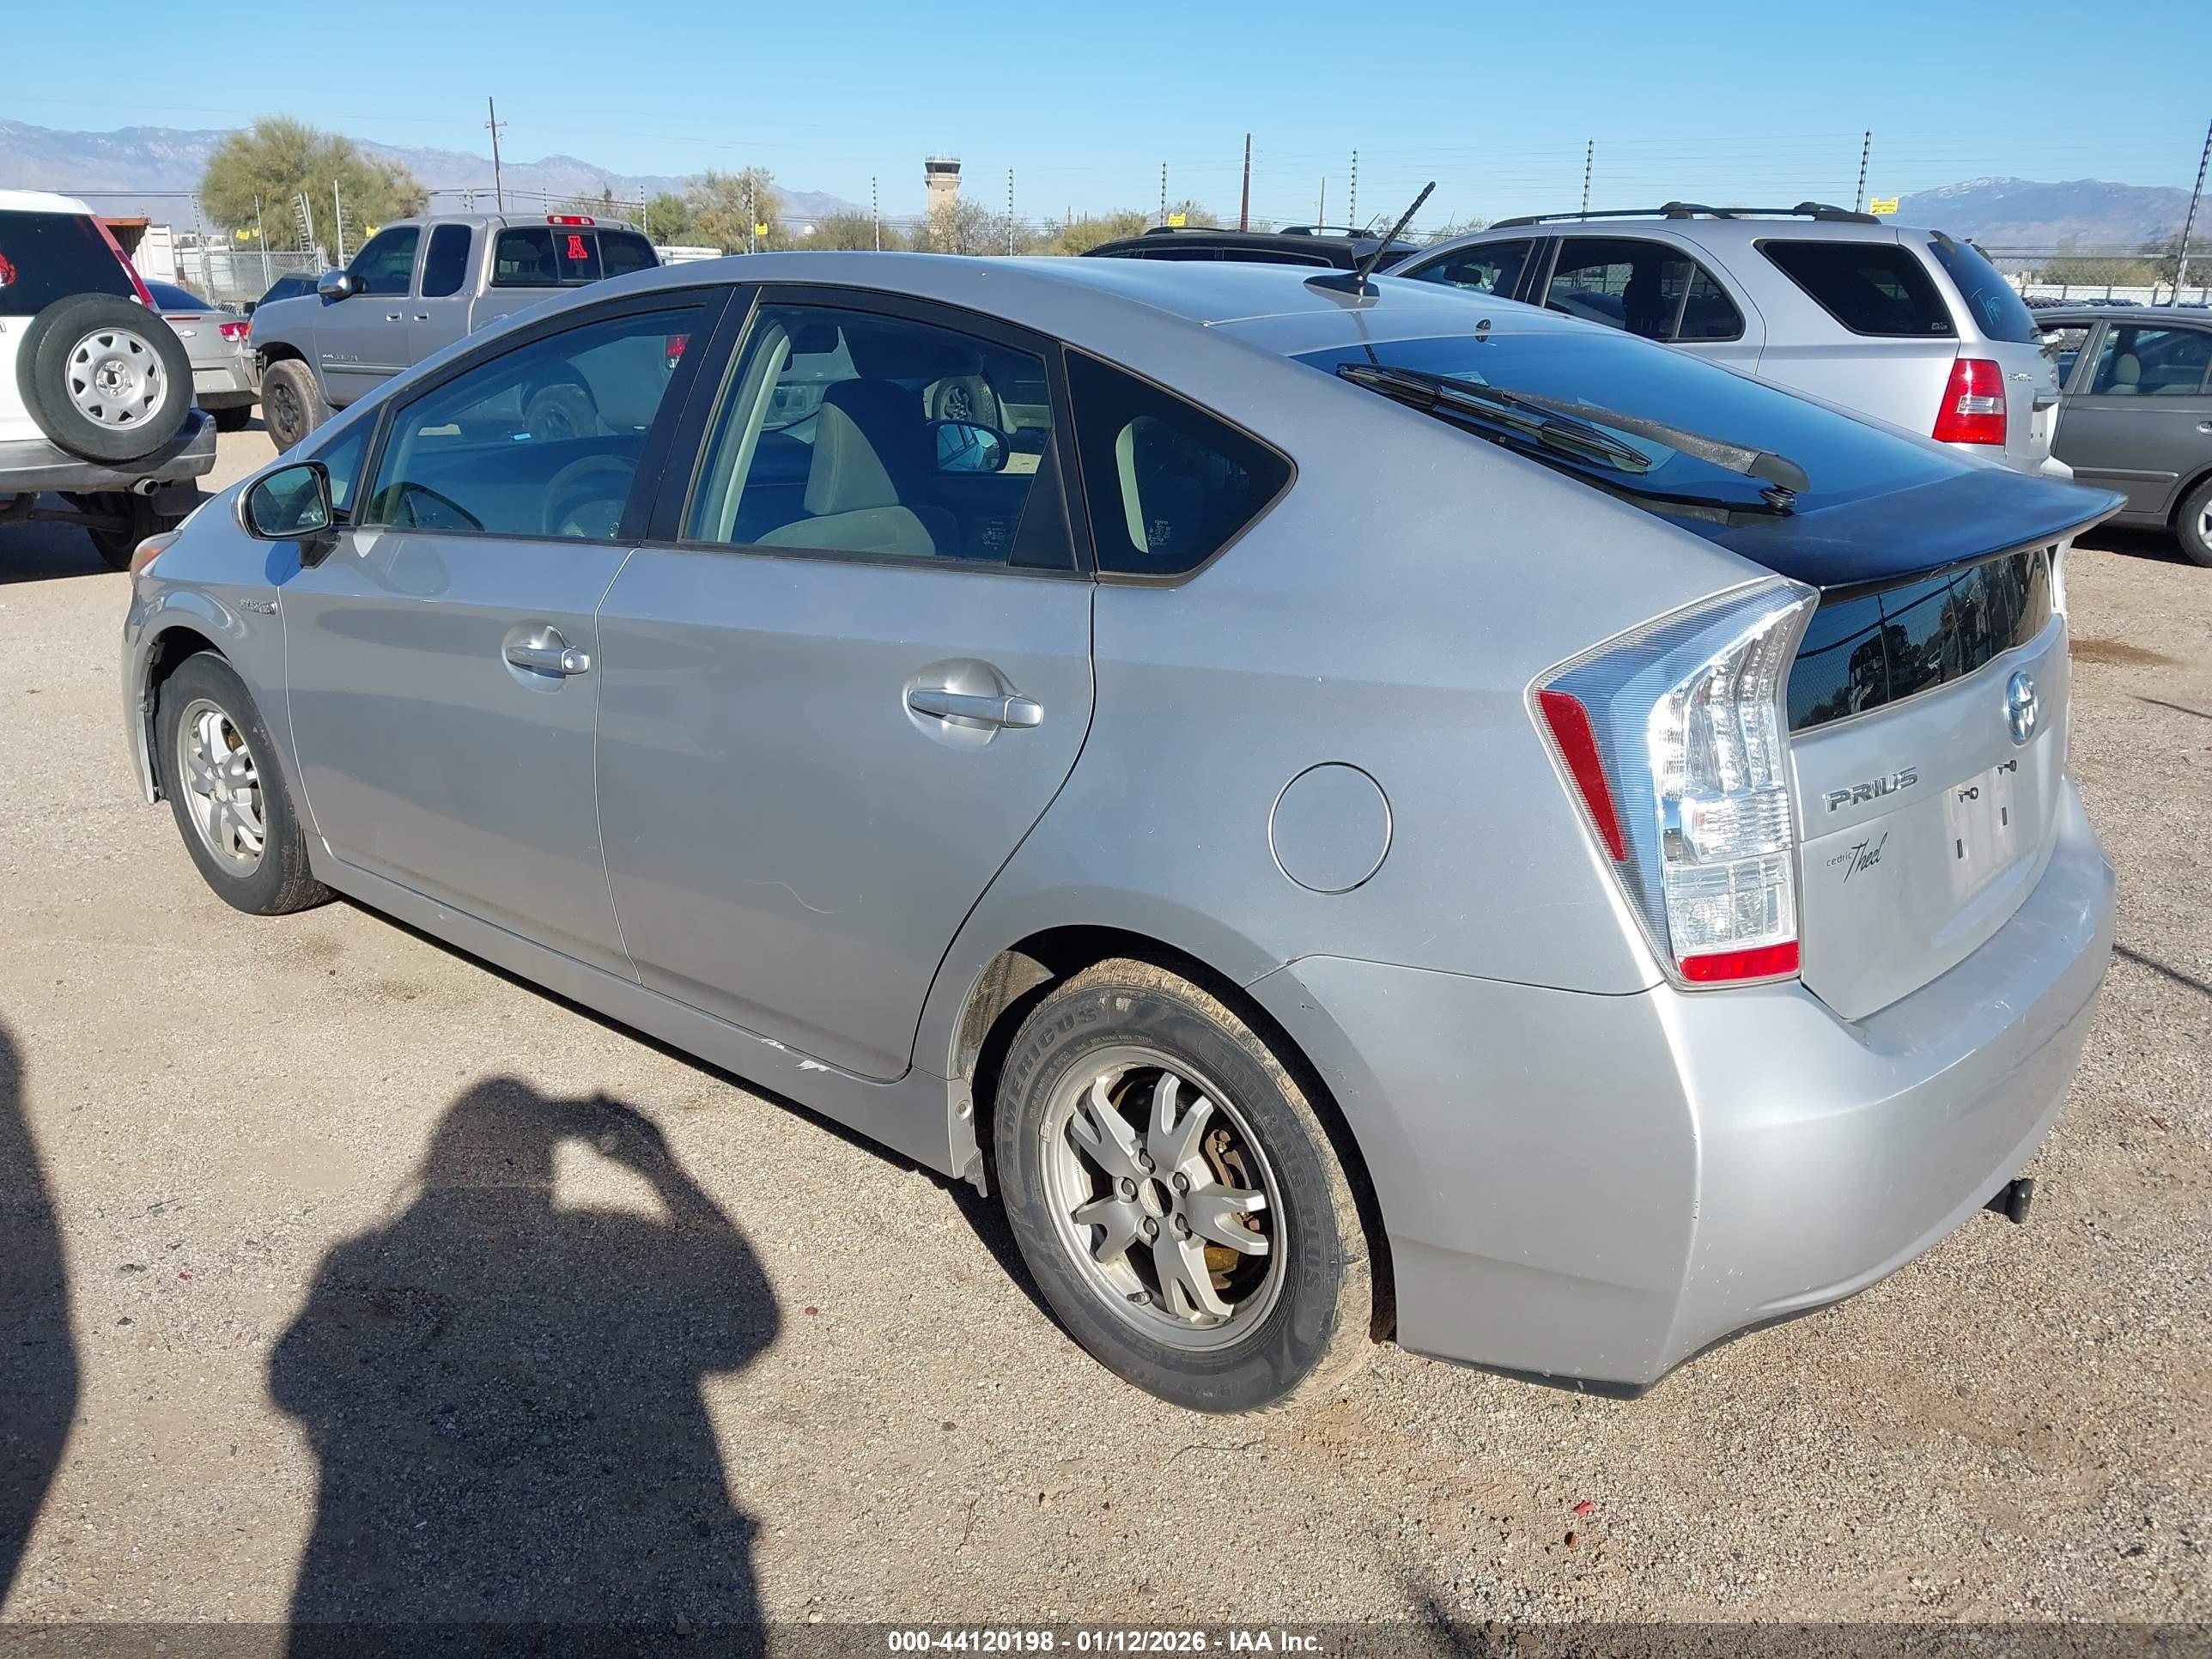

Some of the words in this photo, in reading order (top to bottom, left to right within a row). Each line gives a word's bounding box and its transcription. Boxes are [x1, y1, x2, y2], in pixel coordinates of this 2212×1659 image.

[568, 234, 587, 258] A
[1822, 766, 1918, 813] PRIUS
[1826, 851, 1852, 867] cedric
[1300, 1207, 1321, 1295] PLUS
